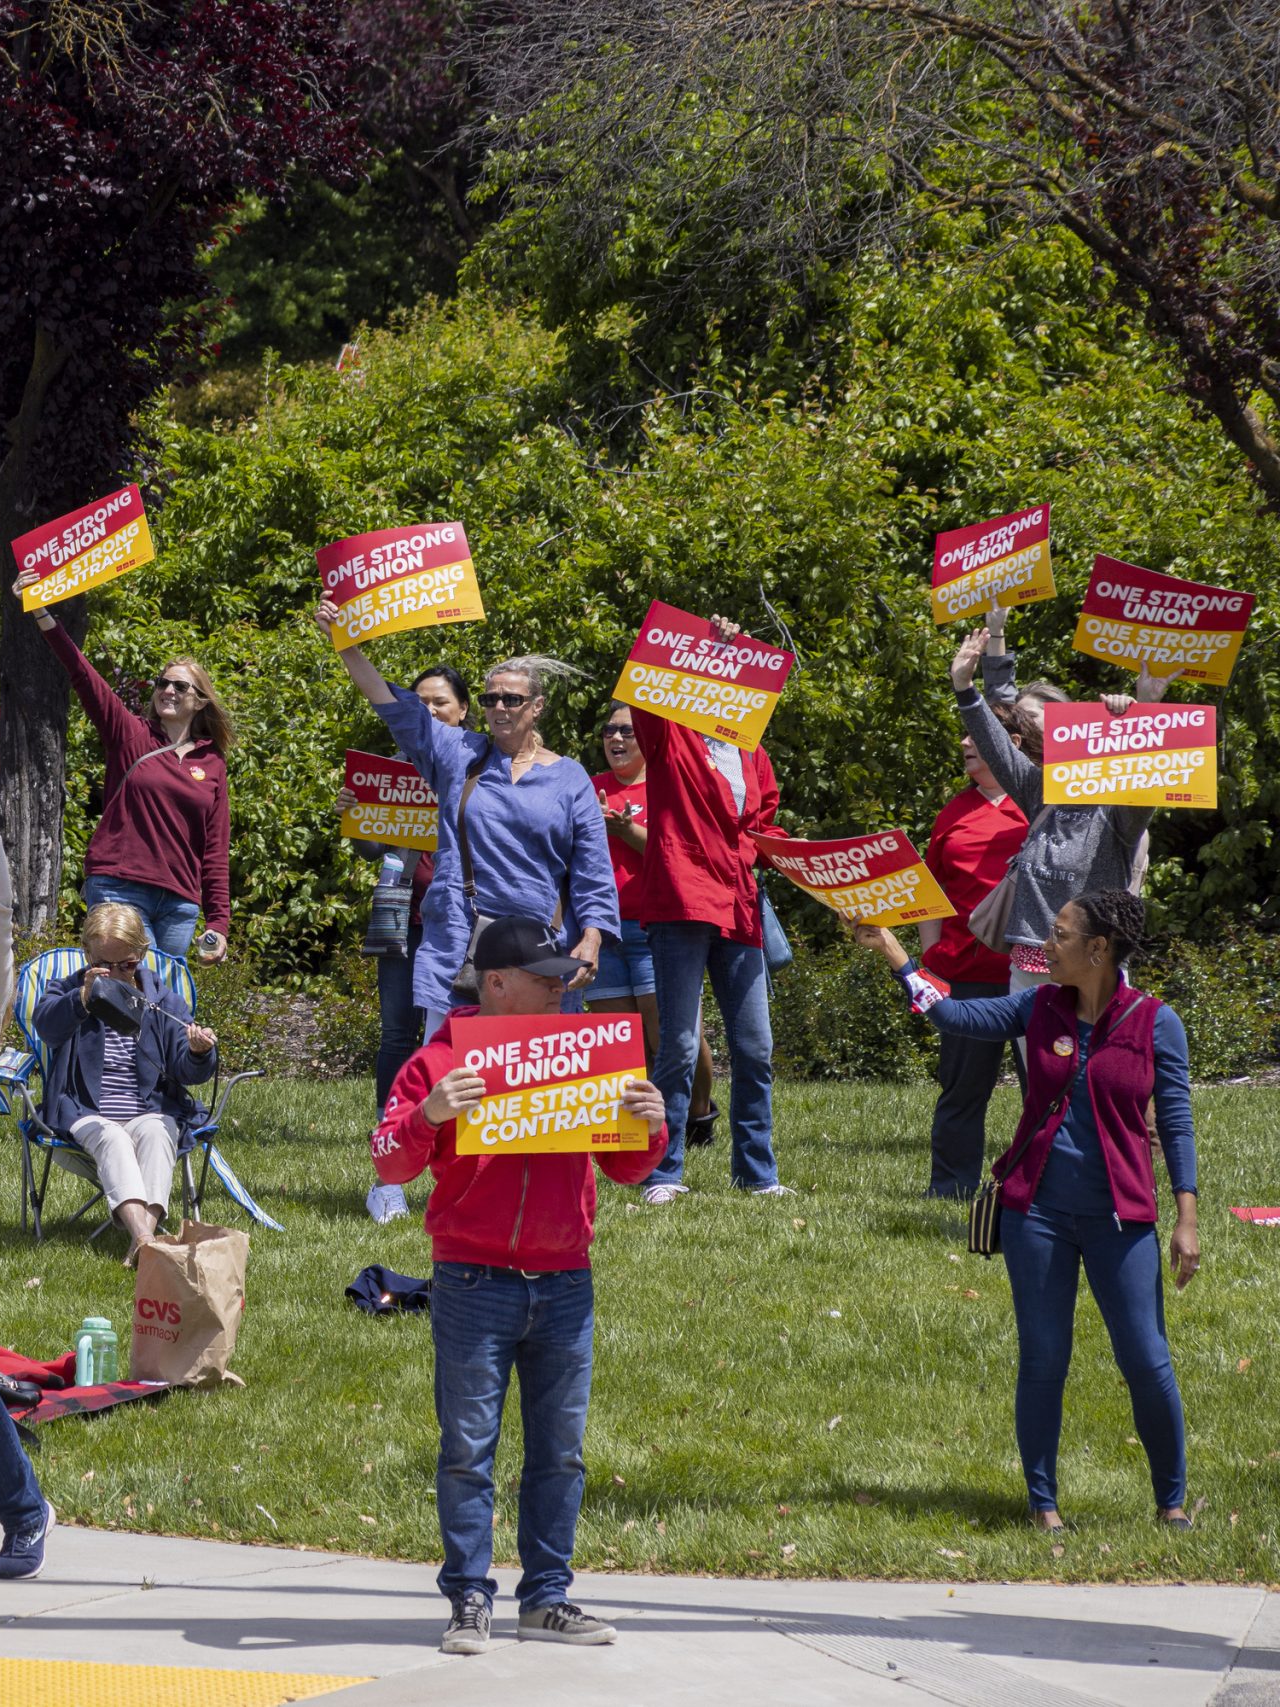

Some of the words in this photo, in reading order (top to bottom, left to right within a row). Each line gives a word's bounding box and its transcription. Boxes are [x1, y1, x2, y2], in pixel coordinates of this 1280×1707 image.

[24, 536, 60, 568] ONE
[62, 491, 132, 545] STRONG
[50, 522, 106, 567] UNION
[940, 540, 976, 567] ONE
[977, 510, 1043, 551] STRONG
[28, 568, 67, 596] ONE
[71, 522, 140, 575] STRONG
[40, 540, 134, 602] CONTRACT
[326, 554, 366, 588] ONE
[370, 527, 456, 567] STRONG
[354, 552, 424, 590] UNION
[961, 536, 1015, 572] UNION
[937, 575, 972, 602] ONE
[974, 545, 1042, 586] STRONG
[947, 564, 1035, 615] CONTRACT
[335, 594, 374, 628] ONE
[378, 564, 465, 604] STRONG
[347, 584, 458, 639] CONTRACT
[1096, 580, 1144, 603] ONE
[1146, 590, 1244, 612] STRONG
[1122, 603, 1200, 626] UNION
[646, 628, 695, 650] ONE
[696, 638, 785, 670] STRONG
[1085, 618, 1134, 641] ONE
[1136, 628, 1232, 648] STRONG
[1092, 637, 1219, 664] CONTRACT
[670, 650, 743, 680] UNION
[629, 666, 678, 688] ONE
[677, 677, 768, 710] STRONG
[634, 686, 752, 723] CONTRACT
[1052, 722, 1104, 743] ONE
[1108, 710, 1206, 736] STRONG
[1087, 730, 1165, 755] UNION
[352, 772, 392, 788] ONE
[396, 776, 431, 791] STR
[1052, 762, 1103, 783] ONE
[1108, 750, 1205, 774] STRONG
[1064, 768, 1194, 798] CONTRACT
[378, 788, 439, 804] UNION
[349, 806, 391, 821] ONE
[394, 809, 438, 823] STRO
[358, 820, 438, 837] CONTRA
[771, 854, 810, 871] ONE
[810, 836, 900, 870] STRONG
[802, 862, 870, 887] UNION
[832, 870, 921, 907] STRONG
[464, 1040, 522, 1072] ONE
[528, 1020, 632, 1060] STRONG
[505, 1050, 590, 1087] UNION
[467, 1095, 523, 1126] ONE
[480, 1100, 624, 1146] CONTRACT
[138, 1298, 182, 1325] CVS
